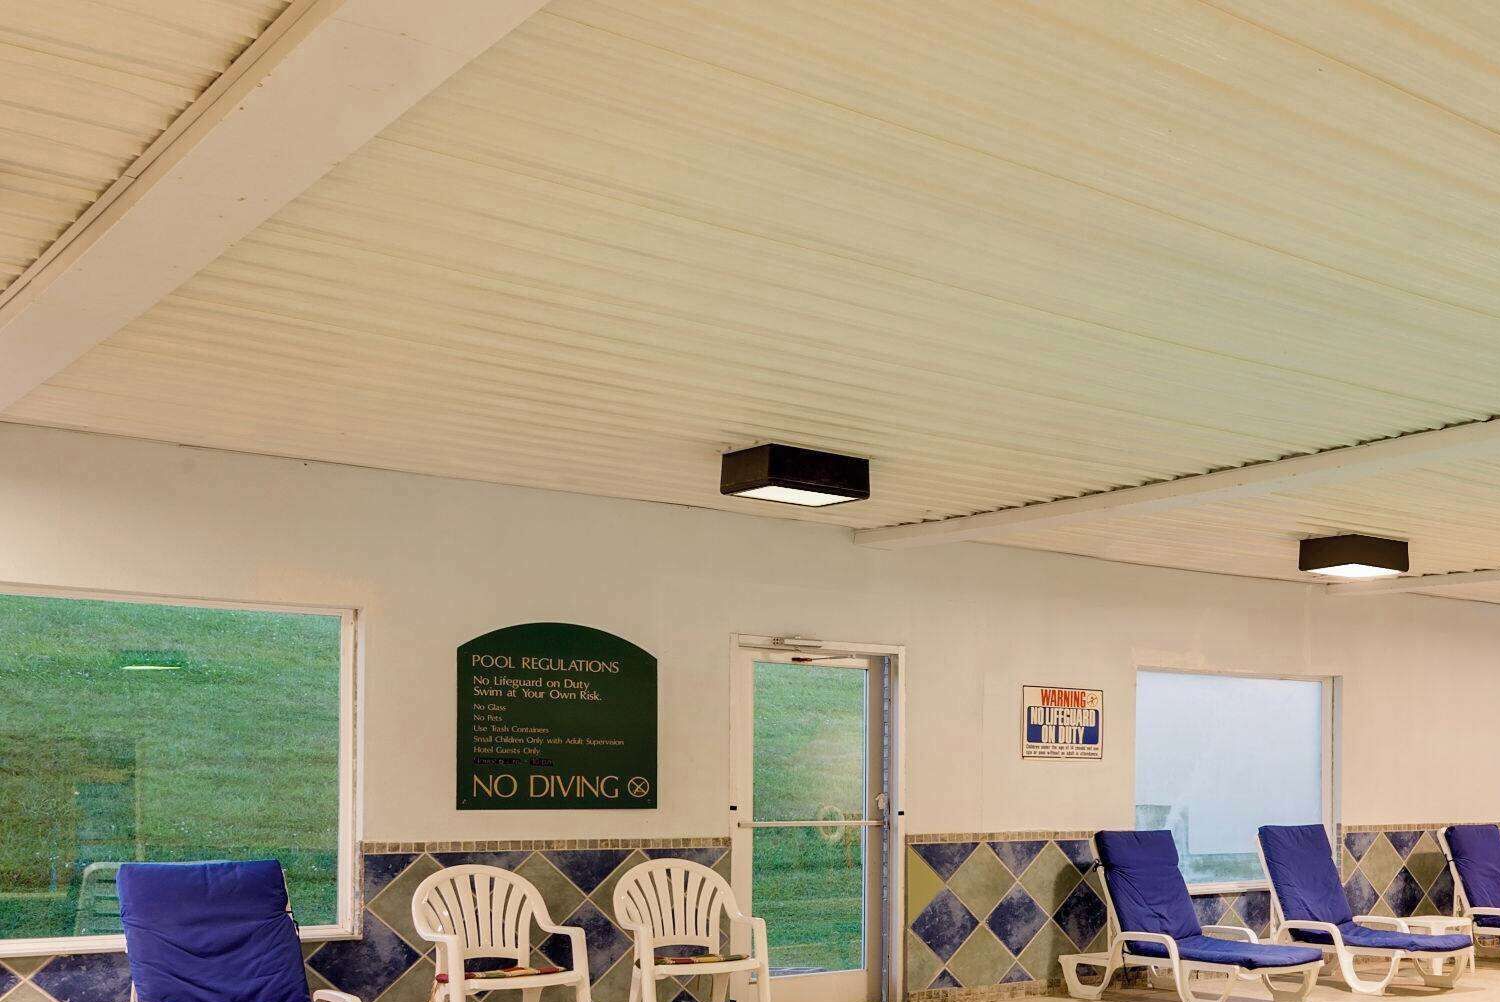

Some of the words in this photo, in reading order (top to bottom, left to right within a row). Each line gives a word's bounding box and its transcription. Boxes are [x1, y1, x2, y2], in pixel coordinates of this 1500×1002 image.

[472, 654, 516, 669] POOL
[521, 656, 620, 674] REGULATIONS
[473, 675, 490, 686] No
[494, 675, 543, 690] Lifeguard
[546, 680, 560, 688] on
[564, 678, 590, 692] Duty
[473, 686, 503, 697] Swim
[506, 688, 517, 698] at
[522, 688, 545, 699] Your
[549, 689, 577, 700] Own
[580, 690, 602, 701] Risk.
[1041, 688, 1086, 708] WARNING
[473, 703, 485, 711] No
[1030, 706, 1045, 726] NO
[1045, 707, 1096, 728] LIFEGUARD
[490, 725, 509, 733] Trash
[1041, 724, 1055, 743] ON
[1058, 725, 1085, 744] DUTY
[473, 735, 493, 743] Small
[495, 736, 524, 744] Children
[546, 737, 563, 745] with
[565, 737, 583, 745] Adult
[473, 746, 494, 754] Hotel
[496, 746, 521, 754] Guests
[473, 774, 518, 798] NO
[529, 774, 619, 799] DIVING
